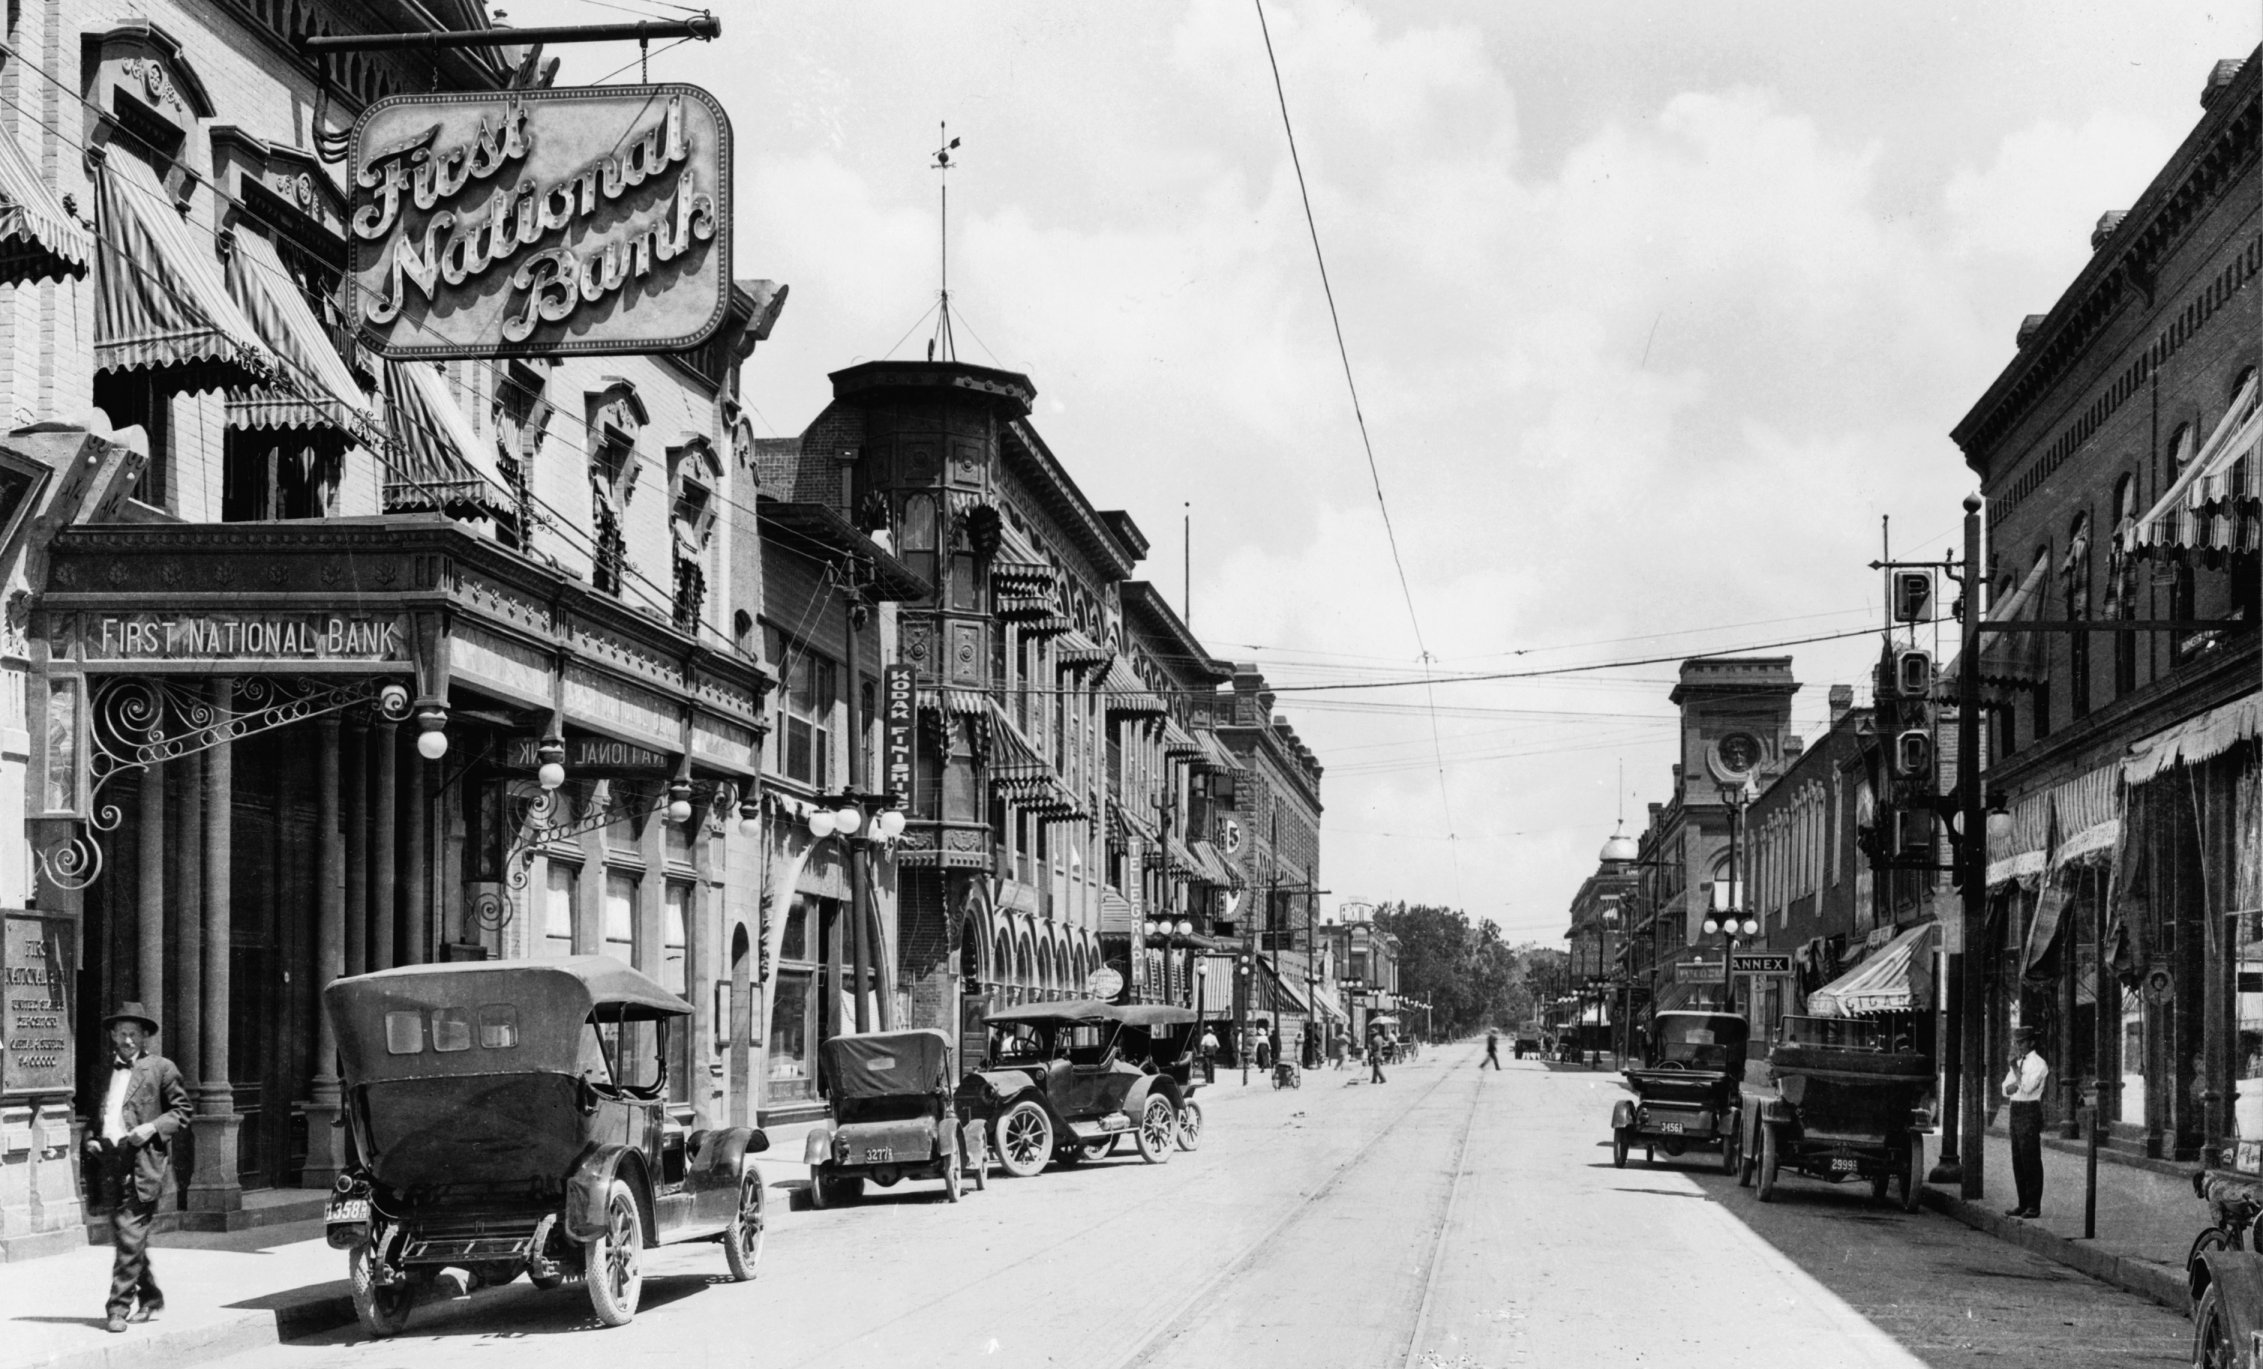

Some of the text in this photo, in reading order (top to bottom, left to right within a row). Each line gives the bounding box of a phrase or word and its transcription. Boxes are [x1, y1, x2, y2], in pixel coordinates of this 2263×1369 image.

[353, 96, 532, 239] First
[367, 94, 693, 323] National
[502, 171, 715, 342] Bank
[102, 618, 394, 653] FIRST NATIONAL BANK
[890, 670, 910, 719] KODAK
[890, 726, 910, 811] FINISHING
[1129, 841, 1143, 981] TELEGRAPH
[1733, 959, 1784, 970] ANNEX
